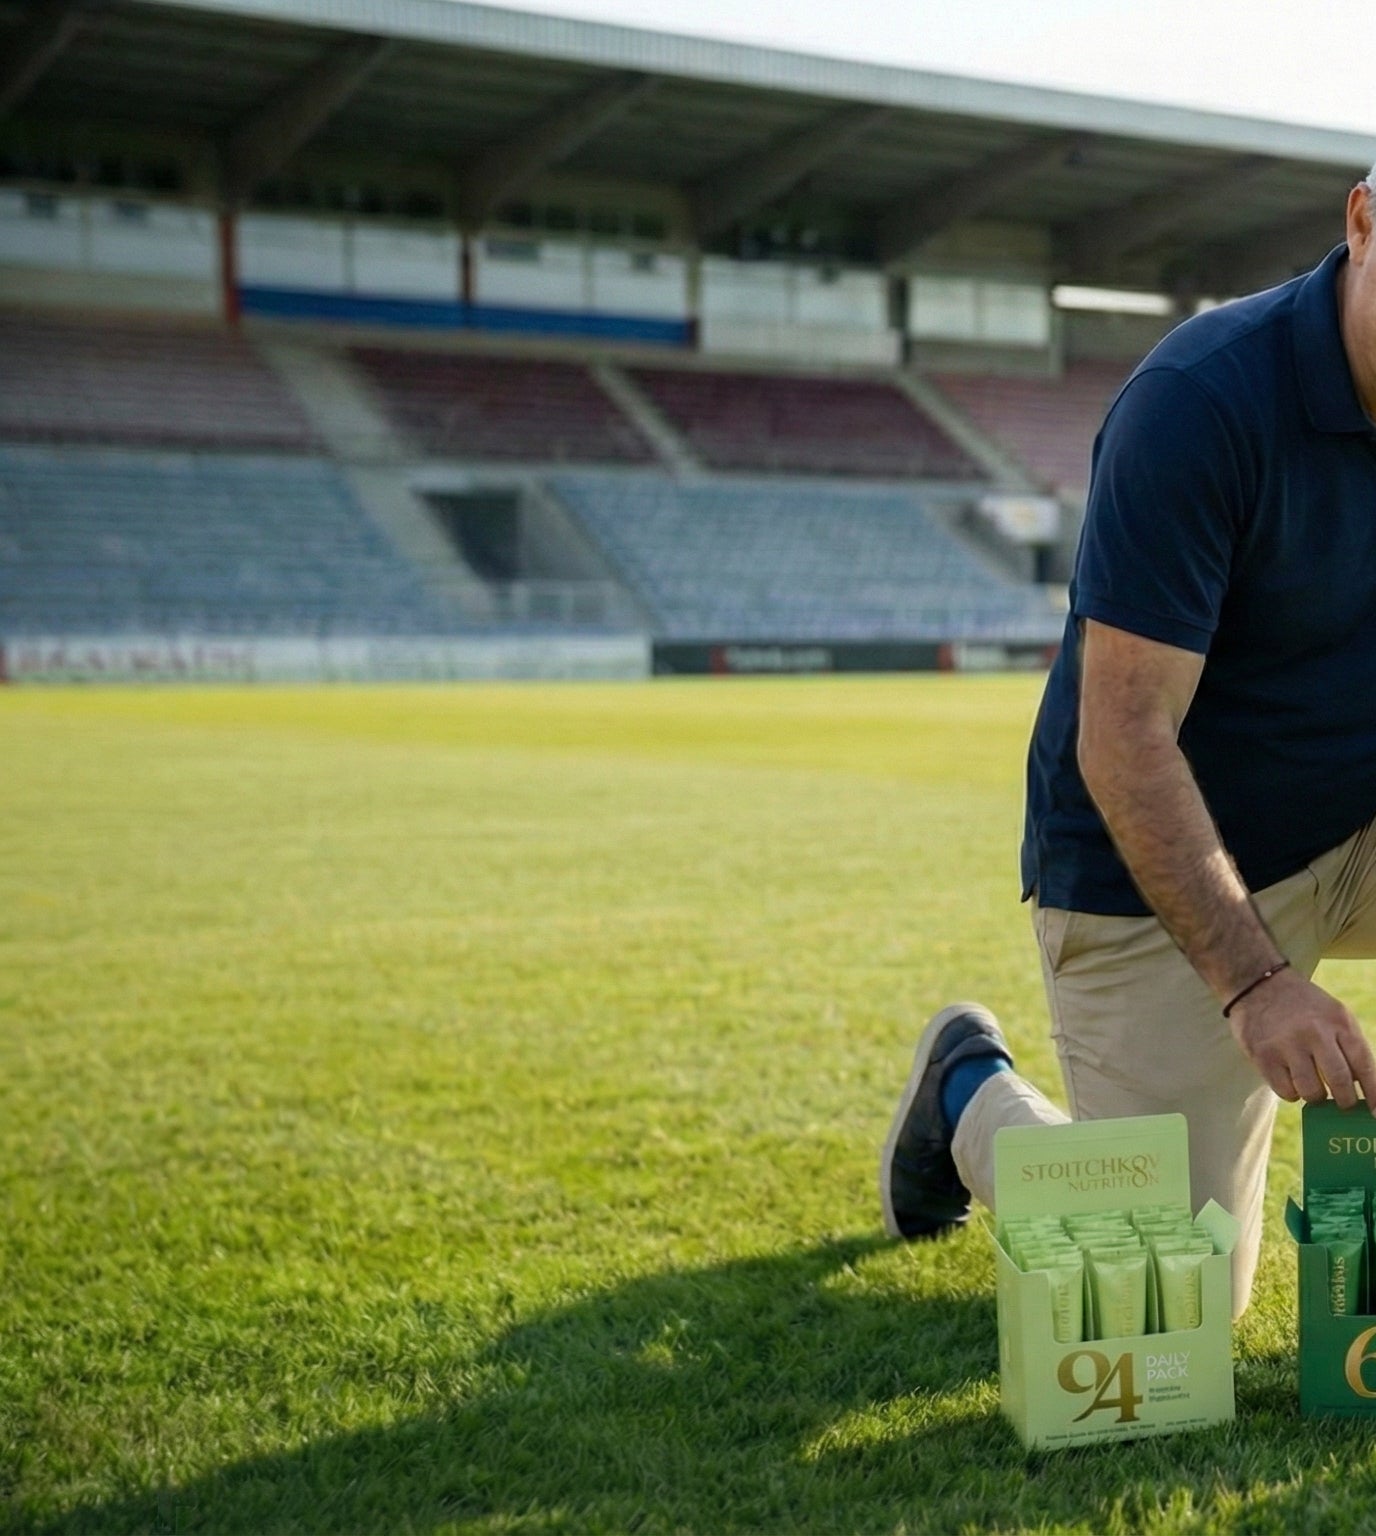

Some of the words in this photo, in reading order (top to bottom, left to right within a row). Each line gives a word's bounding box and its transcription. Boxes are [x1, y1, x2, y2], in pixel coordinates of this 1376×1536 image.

[1021, 1153, 1161, 1183] STOITCHKOV
[1068, 1172, 1160, 1192] NUTRITION
[1146, 1350, 1191, 1368] DAILY
[1147, 1366, 1189, 1380] PACK
[1057, 1350, 1143, 1423] 94
